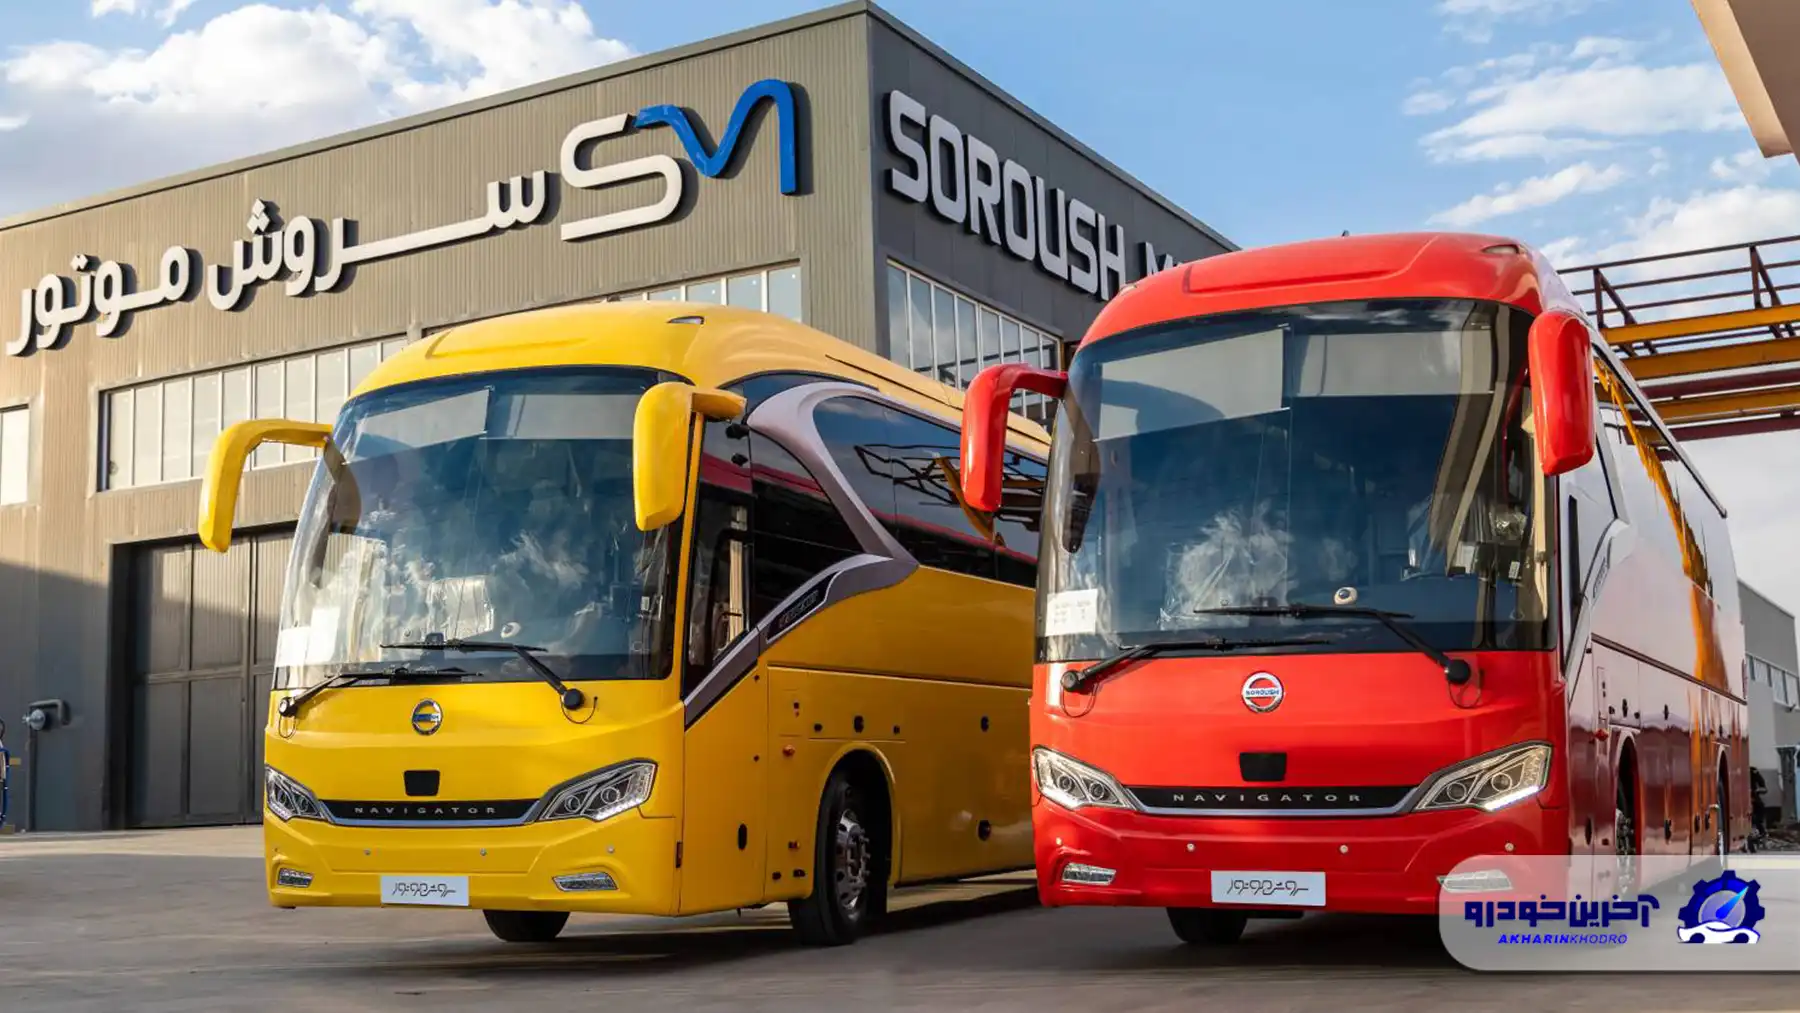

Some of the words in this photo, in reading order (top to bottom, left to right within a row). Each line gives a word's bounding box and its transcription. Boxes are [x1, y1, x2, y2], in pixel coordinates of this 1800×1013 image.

[207, 169, 546, 311] سروش
[889, 89, 1126, 301] SOROUSH
[6, 245, 189, 356] موتور
[353, 806, 496, 814] NAVIGATOR
[1172, 794, 1361, 802] NAVIGATOR
